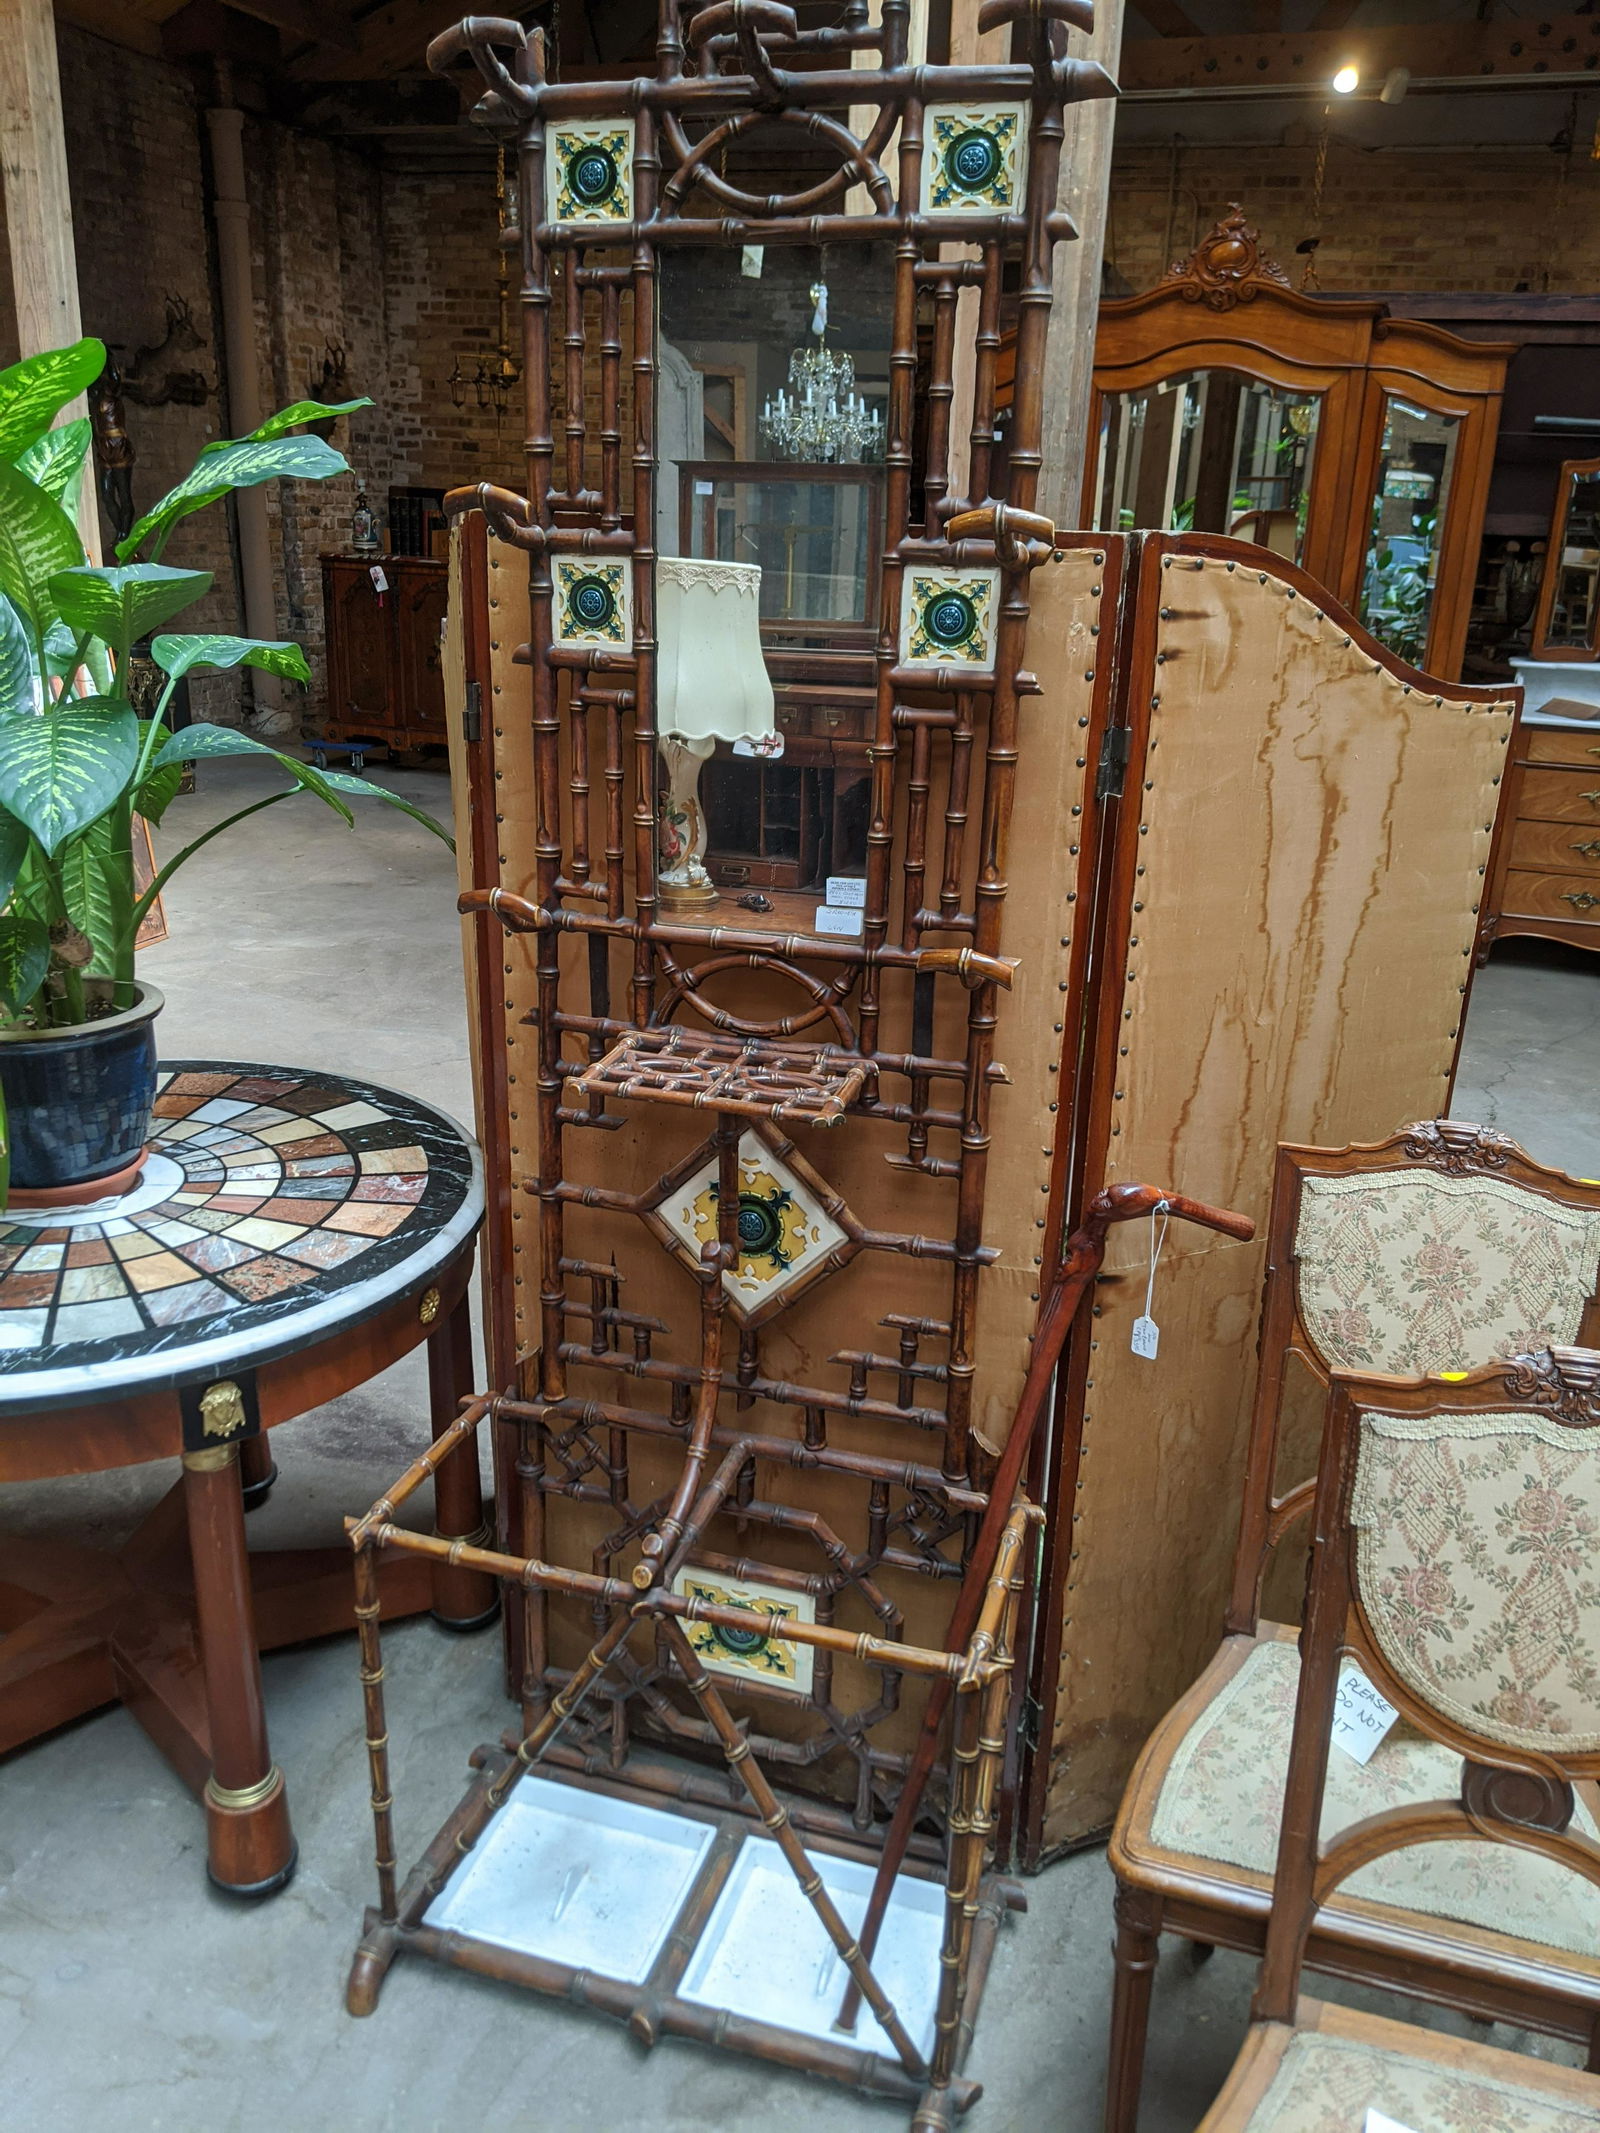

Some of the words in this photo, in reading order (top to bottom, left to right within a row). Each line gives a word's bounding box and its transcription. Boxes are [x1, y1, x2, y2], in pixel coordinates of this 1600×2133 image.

[1336, 1689, 1353, 1708] DO
[1356, 1709, 1386, 1732] NOT
[1345, 1677, 1394, 1712] PLEASE
[1332, 1713, 1355, 1732] IT
